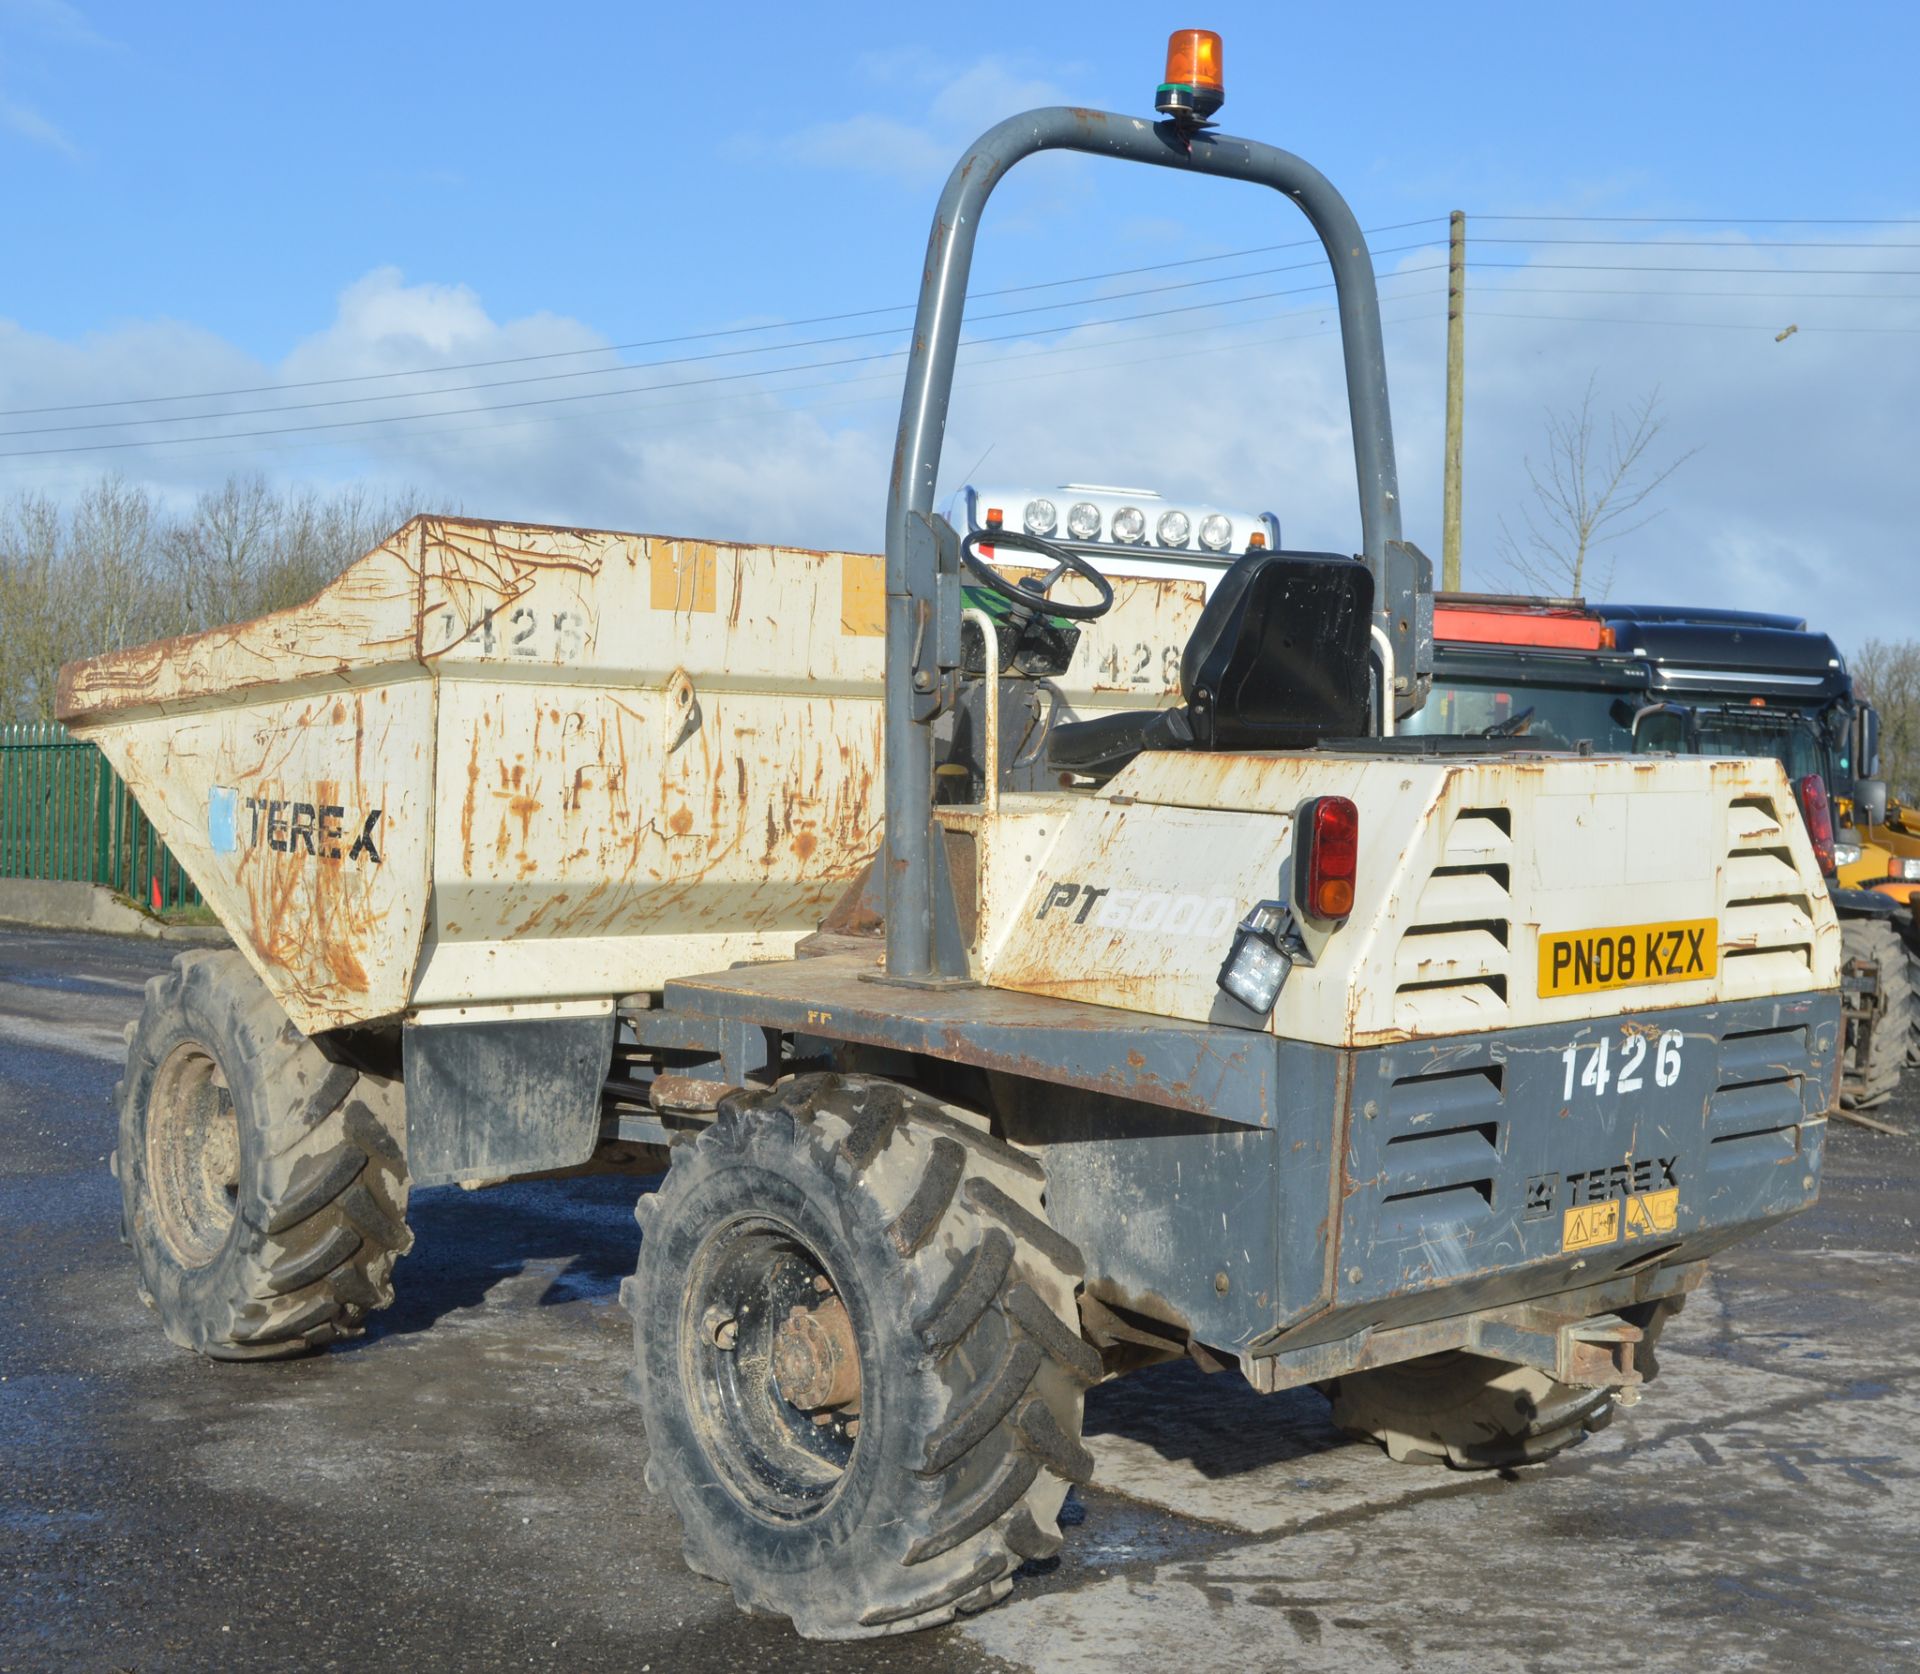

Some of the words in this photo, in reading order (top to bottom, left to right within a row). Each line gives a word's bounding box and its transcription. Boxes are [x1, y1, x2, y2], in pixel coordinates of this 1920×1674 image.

[246, 796, 382, 864] TEREX
[1035, 881, 1236, 938] PT6000
[1552, 935, 1636, 989] PN08
[1644, 928, 1704, 978] KZX
[1562, 1028, 1684, 1101] 1426
[1566, 1155, 1679, 1206] TEREX
